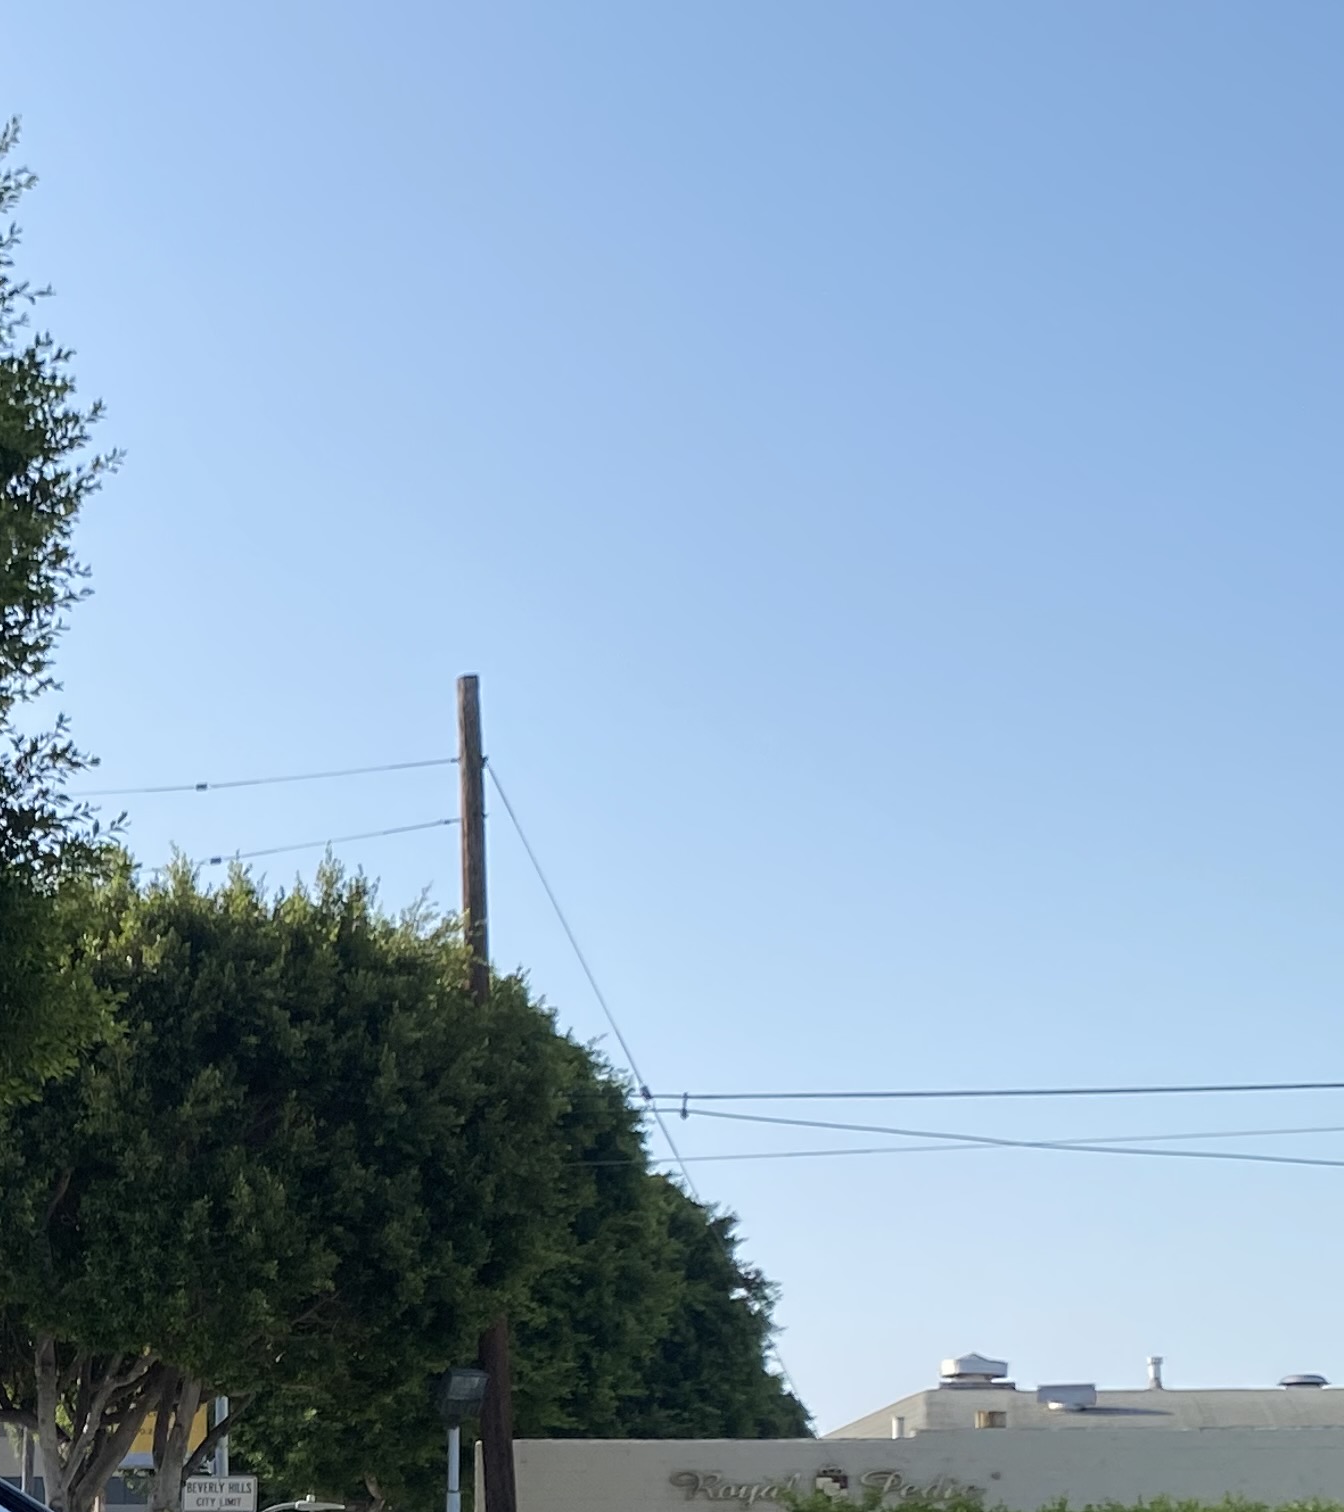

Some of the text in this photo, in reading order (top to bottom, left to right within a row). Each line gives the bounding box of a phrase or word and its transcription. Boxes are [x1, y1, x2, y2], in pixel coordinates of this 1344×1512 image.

[186, 1482, 252, 1494] BEVERLY HILLS
[196, 1497, 242, 1507] CITY LIMIT
